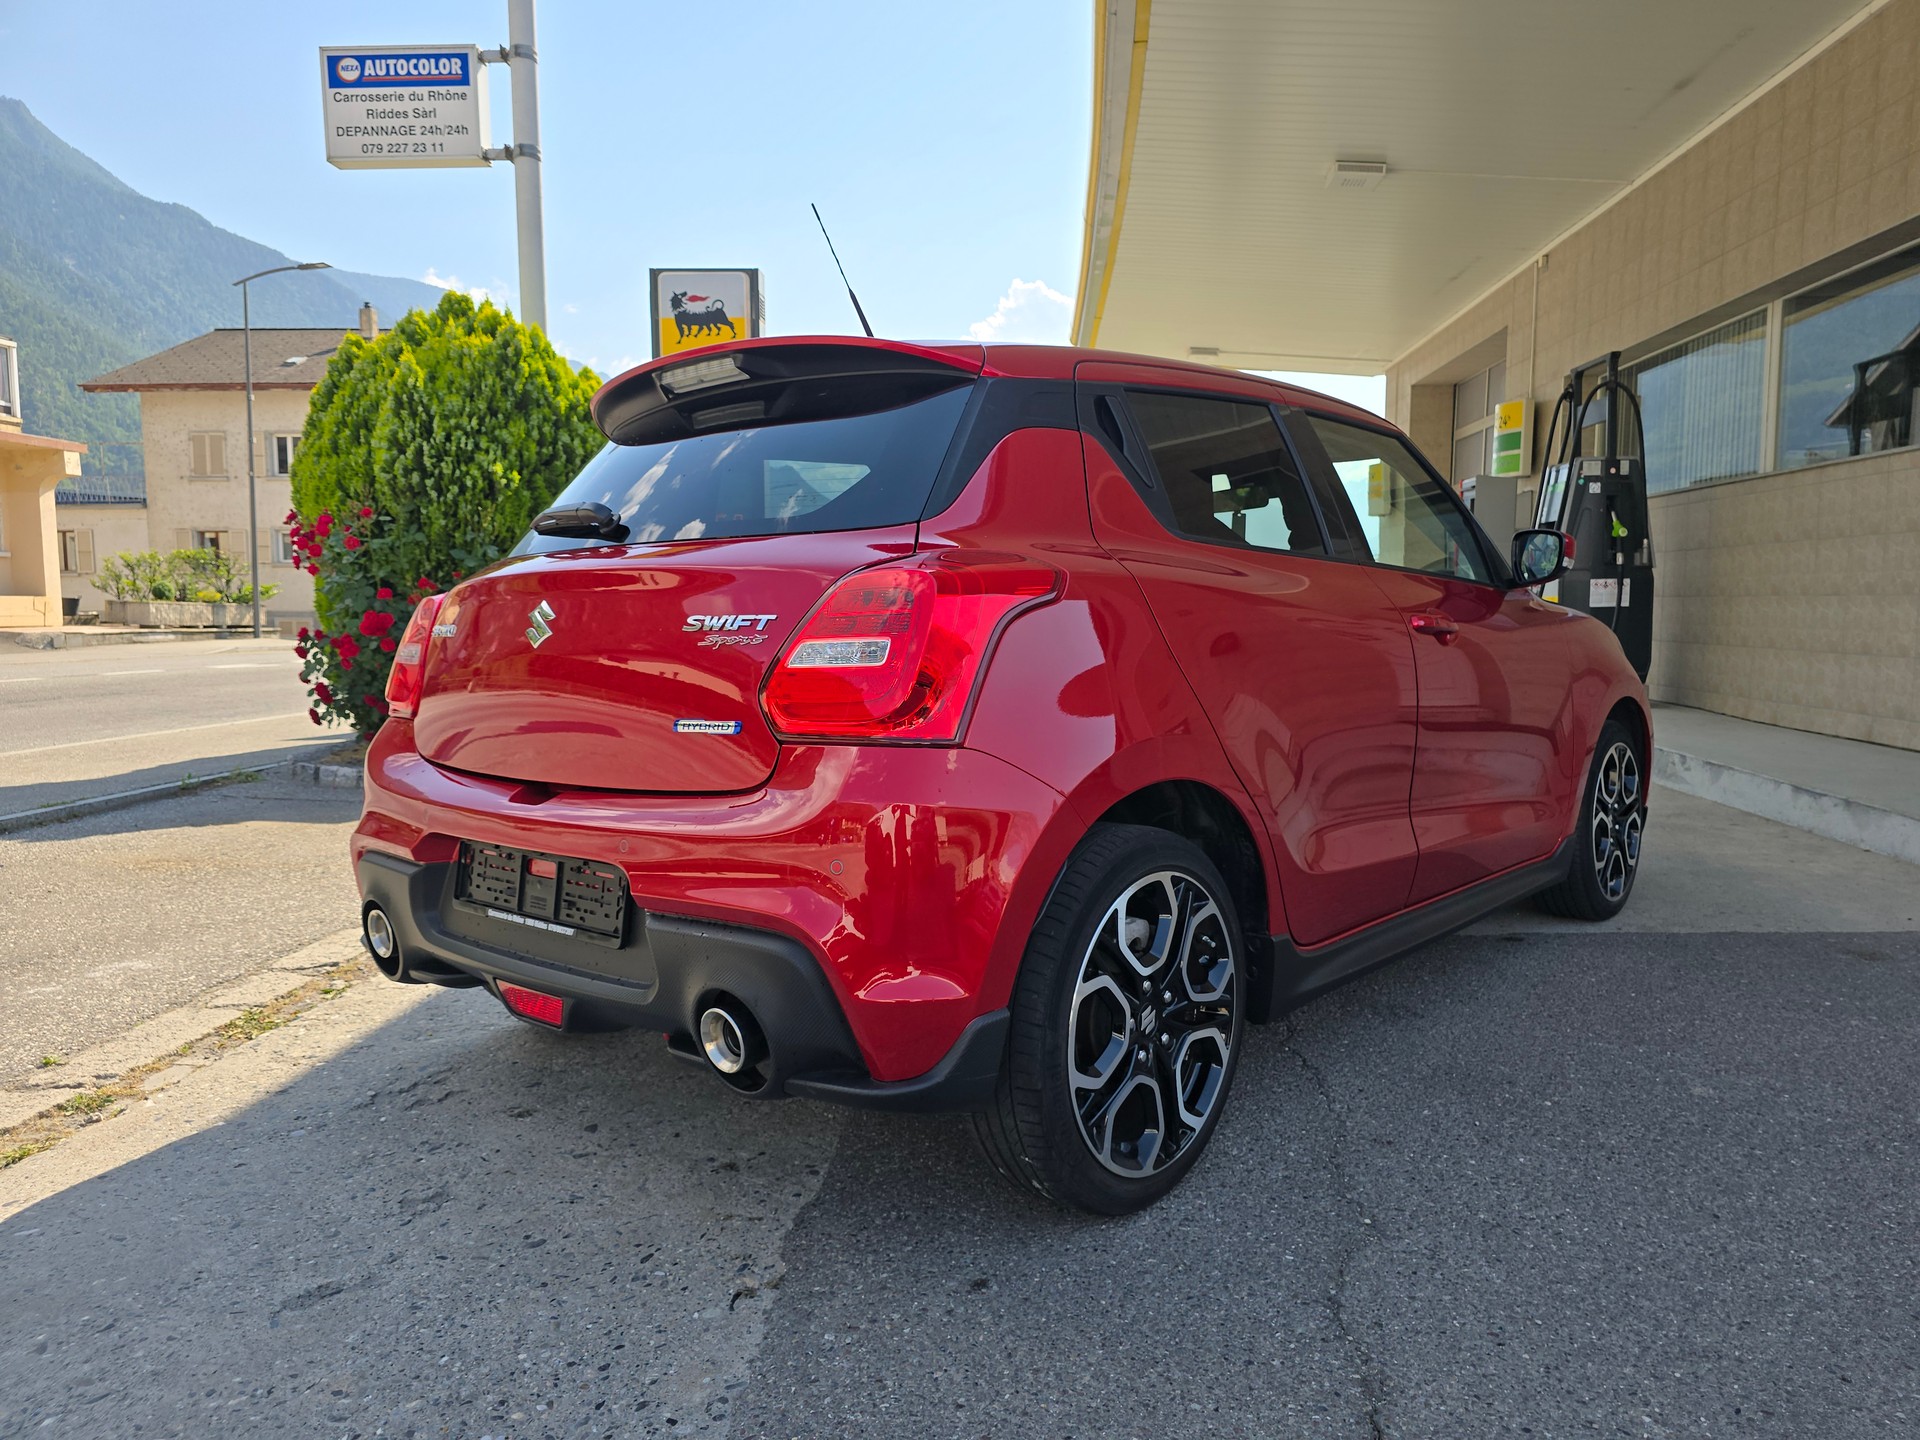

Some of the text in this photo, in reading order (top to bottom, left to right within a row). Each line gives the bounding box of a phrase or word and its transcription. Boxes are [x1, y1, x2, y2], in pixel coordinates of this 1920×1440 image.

[340, 64, 360, 72] NEXA
[364, 58, 462, 76] AUTOCOLOR
[333, 89, 468, 103] Carrosserie du Rhône
[366, 108, 409, 119] Riddes
[336, 124, 468, 137] DEPANNAGE 24h/24h
[361, 142, 444, 154] 079 227 23 11
[682, 614, 777, 631] SWIFT
[697, 634, 769, 650] Sport
[682, 722, 730, 731] HYBRID
